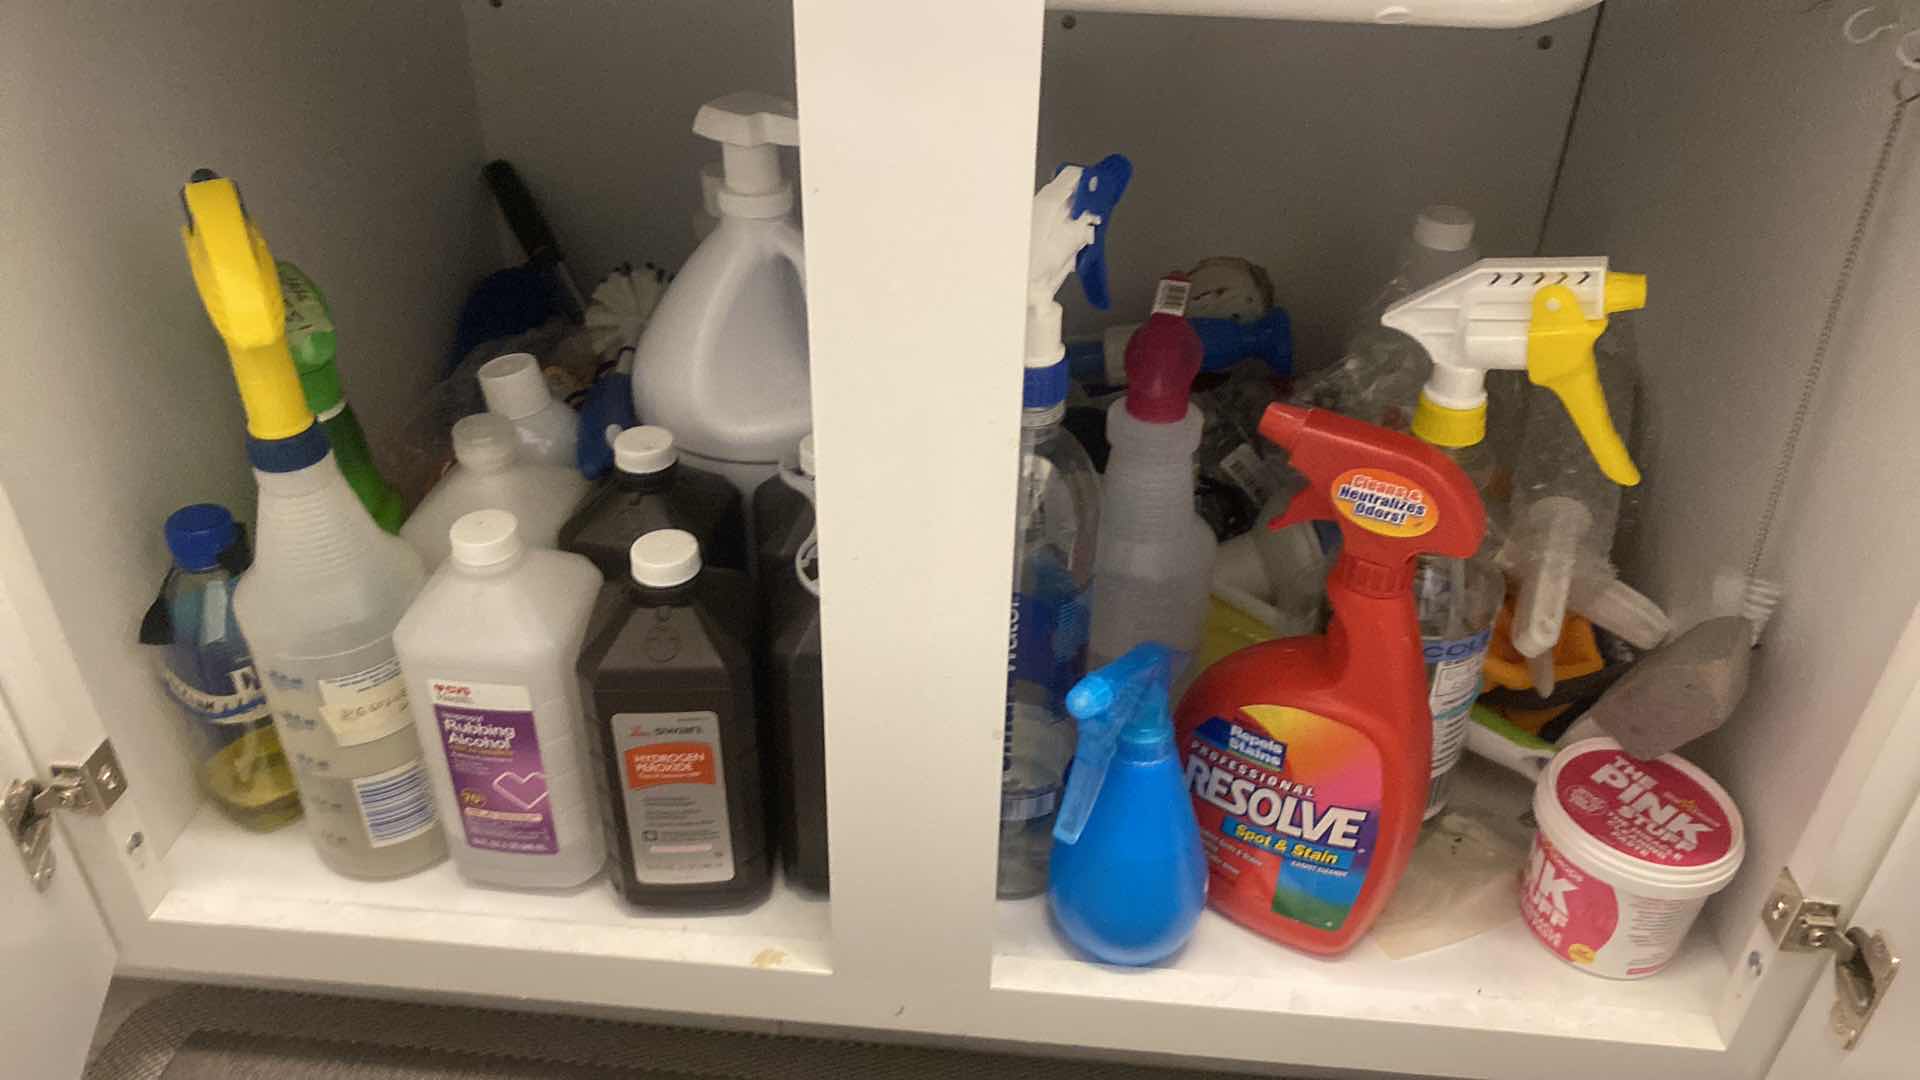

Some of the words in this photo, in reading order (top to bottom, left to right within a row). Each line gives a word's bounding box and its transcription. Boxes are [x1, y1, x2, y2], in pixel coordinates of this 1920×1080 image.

[1340, 484, 1426, 516] Neutralizes
[1351, 474, 1408, 498] Cleans
[1354, 502, 1407, 524] Odors!
[444, 719, 516, 739] Rubbing
[449, 732, 512, 749] Alcohol
[1230, 725, 1283, 754] Repels
[1228, 737, 1281, 766] Stains
[1191, 740, 1314, 797] PROFESSIONAL
[1612, 755, 1659, 788] THE
[1184, 754, 1367, 849] RESOLVE
[1589, 763, 1714, 847] PINK
[1235, 824, 1272, 848] Spot
[1273, 839, 1288, 853] &
[1290, 844, 1339, 865] Stain
